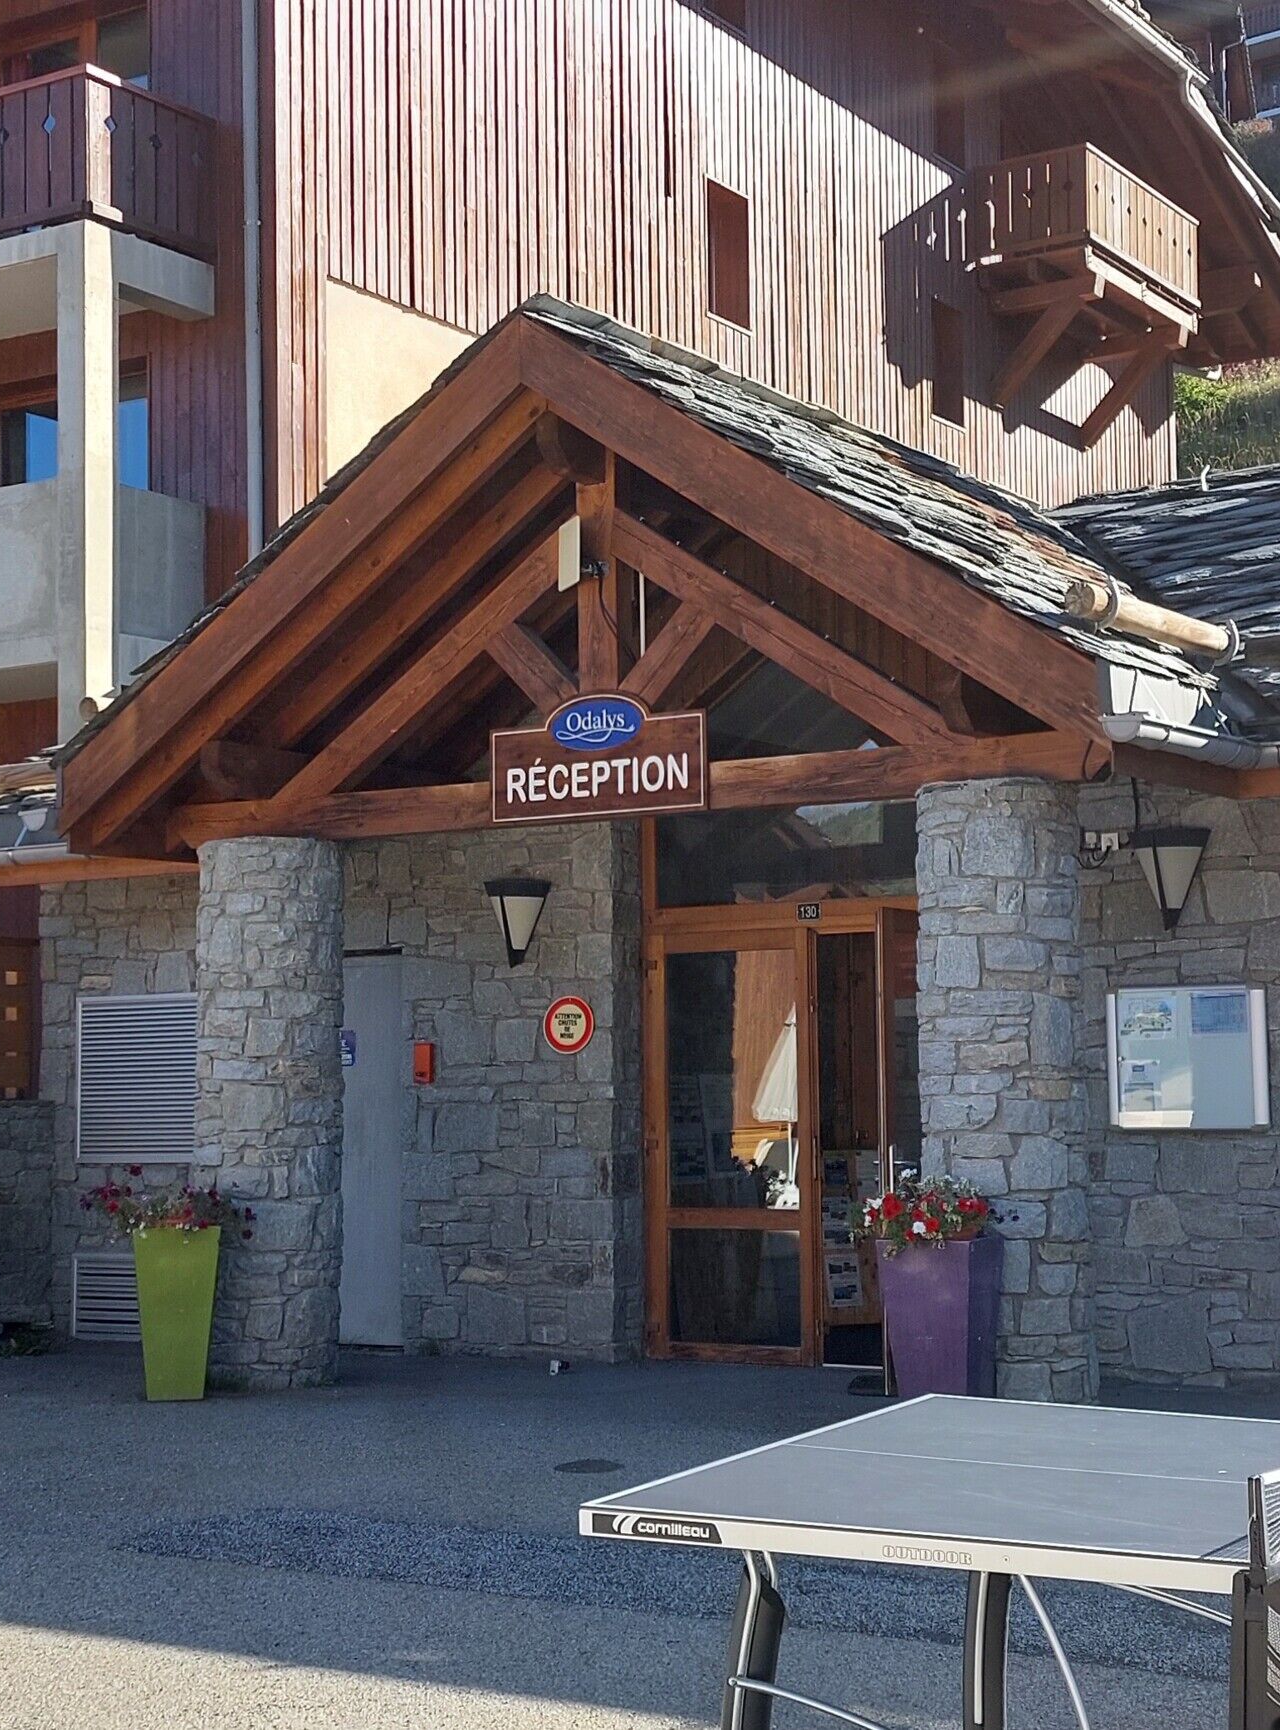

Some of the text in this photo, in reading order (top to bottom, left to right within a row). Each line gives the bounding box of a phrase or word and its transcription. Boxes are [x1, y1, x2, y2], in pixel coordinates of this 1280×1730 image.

[566, 709, 626, 742] Odalys
[506, 752, 689, 804] RÉCEPTION
[800, 905, 817, 918] 130
[637, 1521, 710, 1538] cornilleau
[882, 1545, 973, 1566] OUTDOOR
